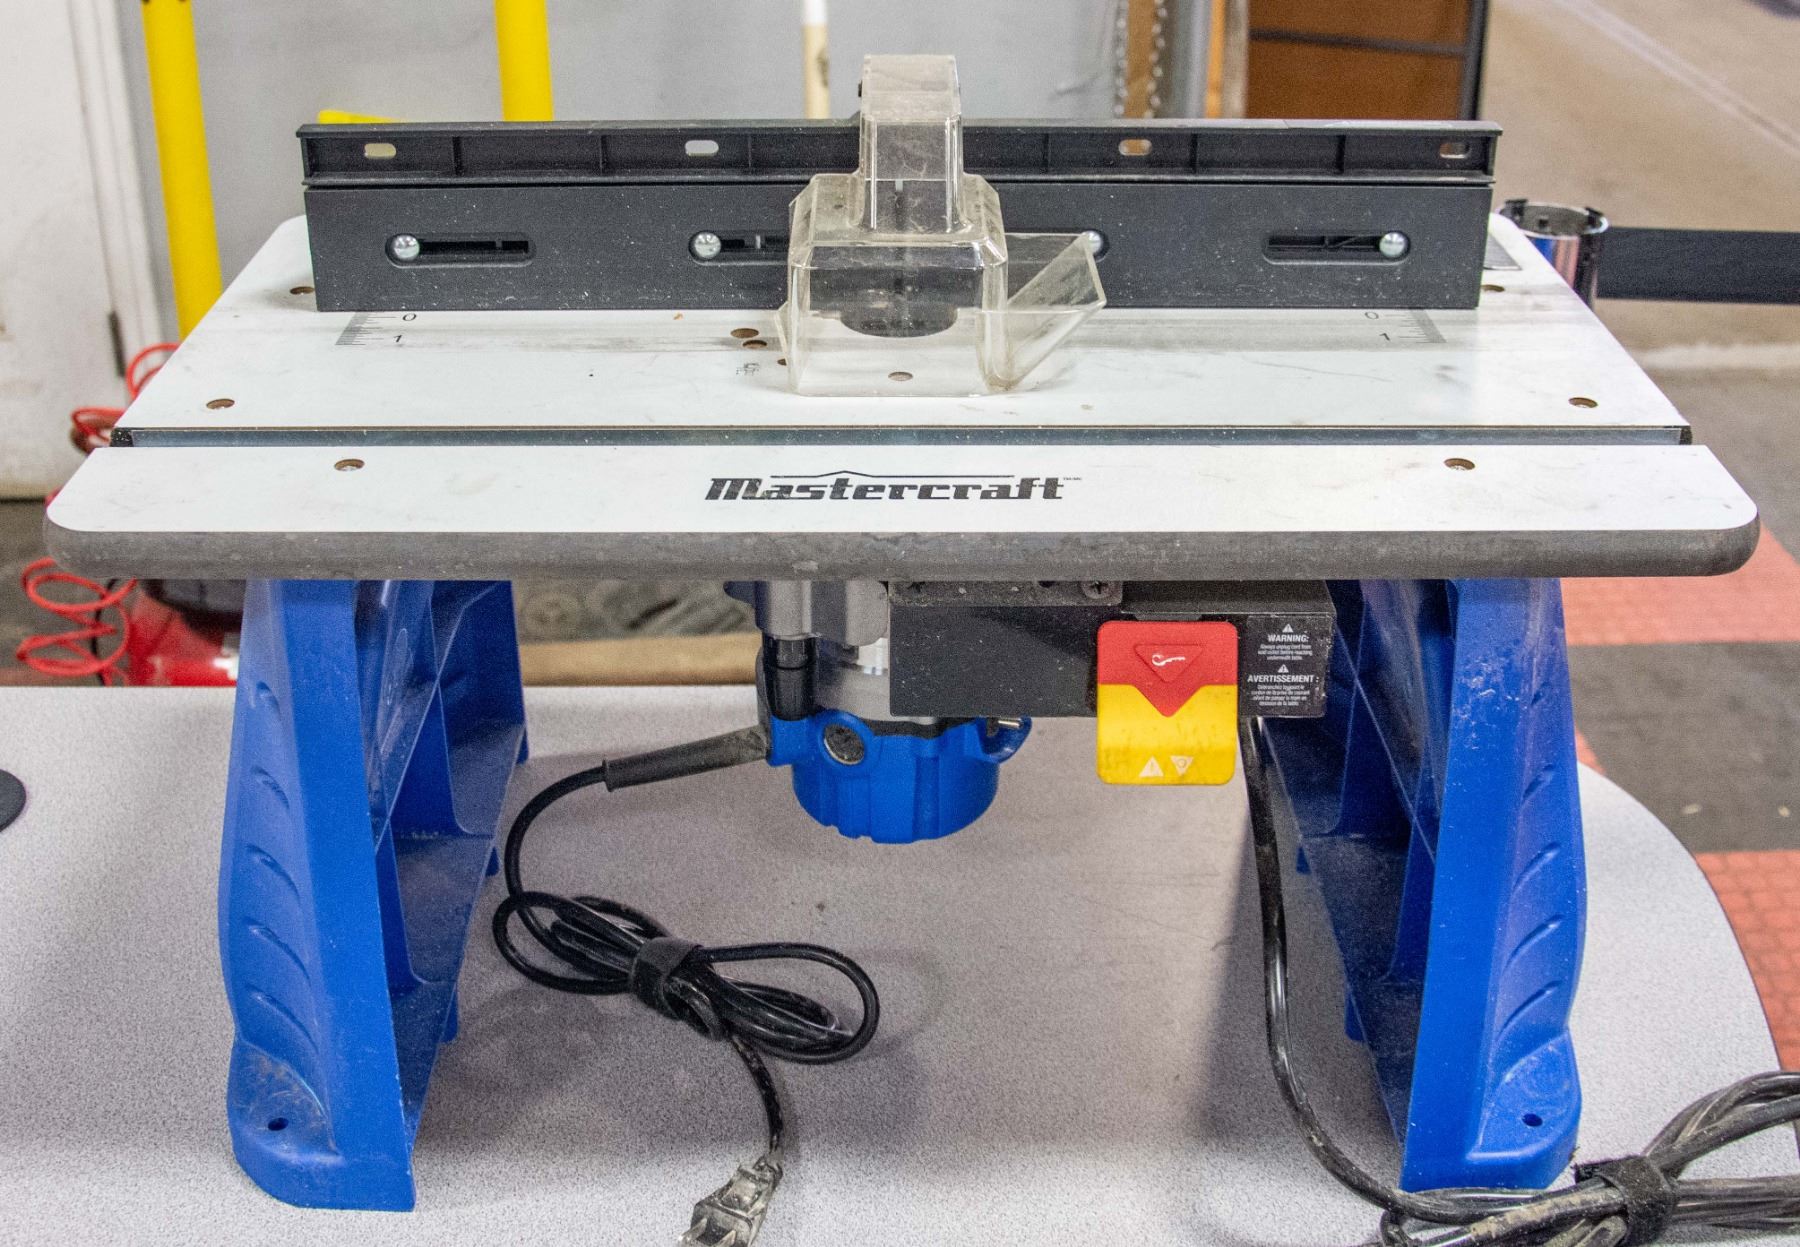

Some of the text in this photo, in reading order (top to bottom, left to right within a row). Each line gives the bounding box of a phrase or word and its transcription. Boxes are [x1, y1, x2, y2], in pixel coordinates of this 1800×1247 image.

[402, 313, 417, 321] 0
[1364, 311, 1379, 320] 0
[393, 334, 403, 343] 1
[1379, 332, 1391, 342] 1
[704, 477, 1065, 500] Mastercraft
[1267, 634, 1310, 642] WARNING:
